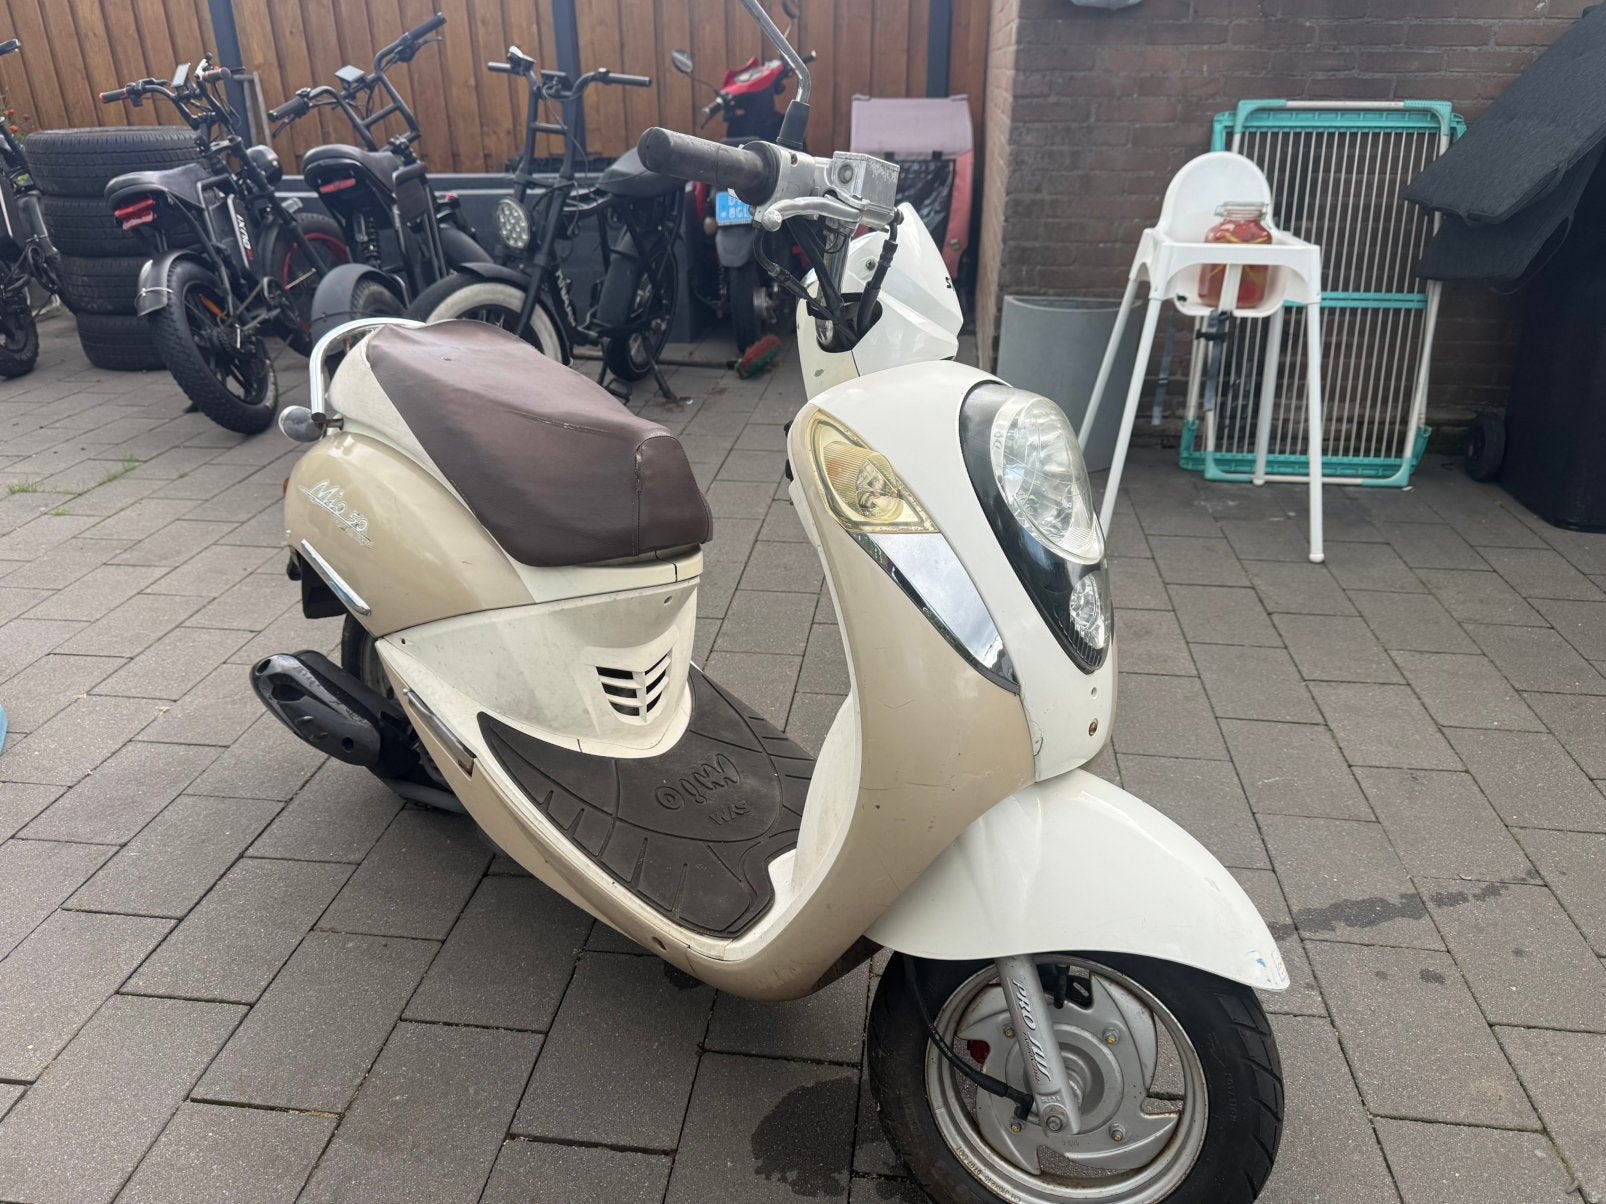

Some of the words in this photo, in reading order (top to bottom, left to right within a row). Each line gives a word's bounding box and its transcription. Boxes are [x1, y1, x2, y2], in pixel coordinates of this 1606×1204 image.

[309, 479, 346, 515] Mio
[349, 511, 369, 532] 50
[709, 800, 751, 826] SYM
[1012, 978, 1037, 1031] PRO
